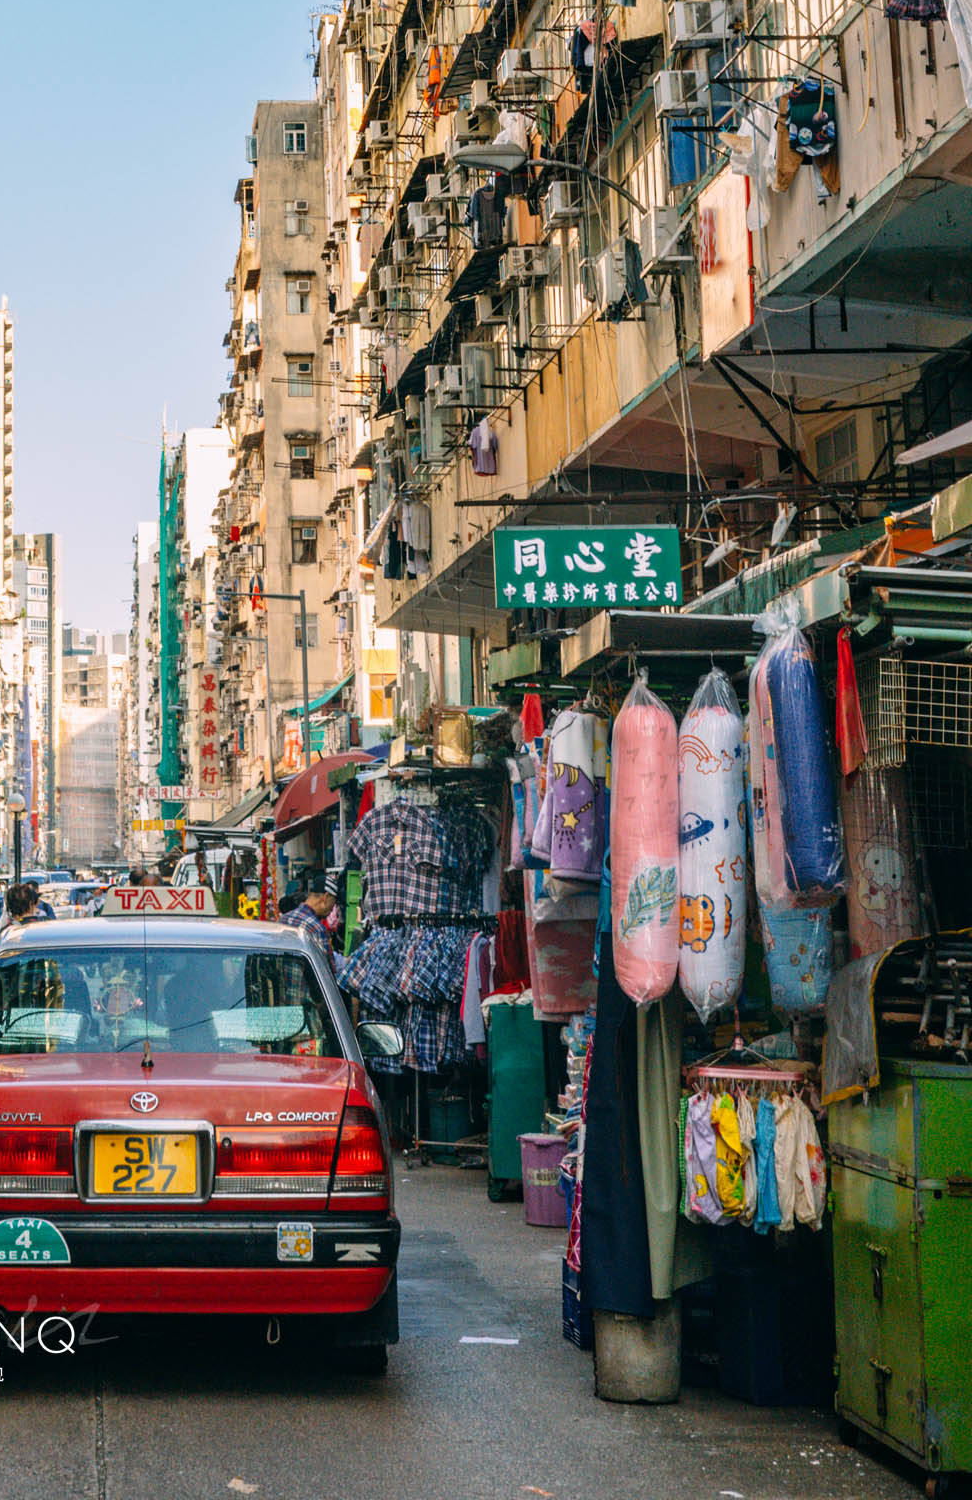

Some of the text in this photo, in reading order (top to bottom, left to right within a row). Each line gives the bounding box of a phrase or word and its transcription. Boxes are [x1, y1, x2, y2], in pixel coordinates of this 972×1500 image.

[514, 532, 662, 578] 同心堂
[503, 581, 678, 604] 中醫藥診所有限公司
[114, 889, 205, 910] TAXI
[245, 1111, 338, 1122] LPG COMFORT
[124, 1137, 166, 1165] SW
[112, 1164, 177, 1192] 227
[6, 1218, 44, 1230] TAXI
[15, 1229, 32, 1249] 4
